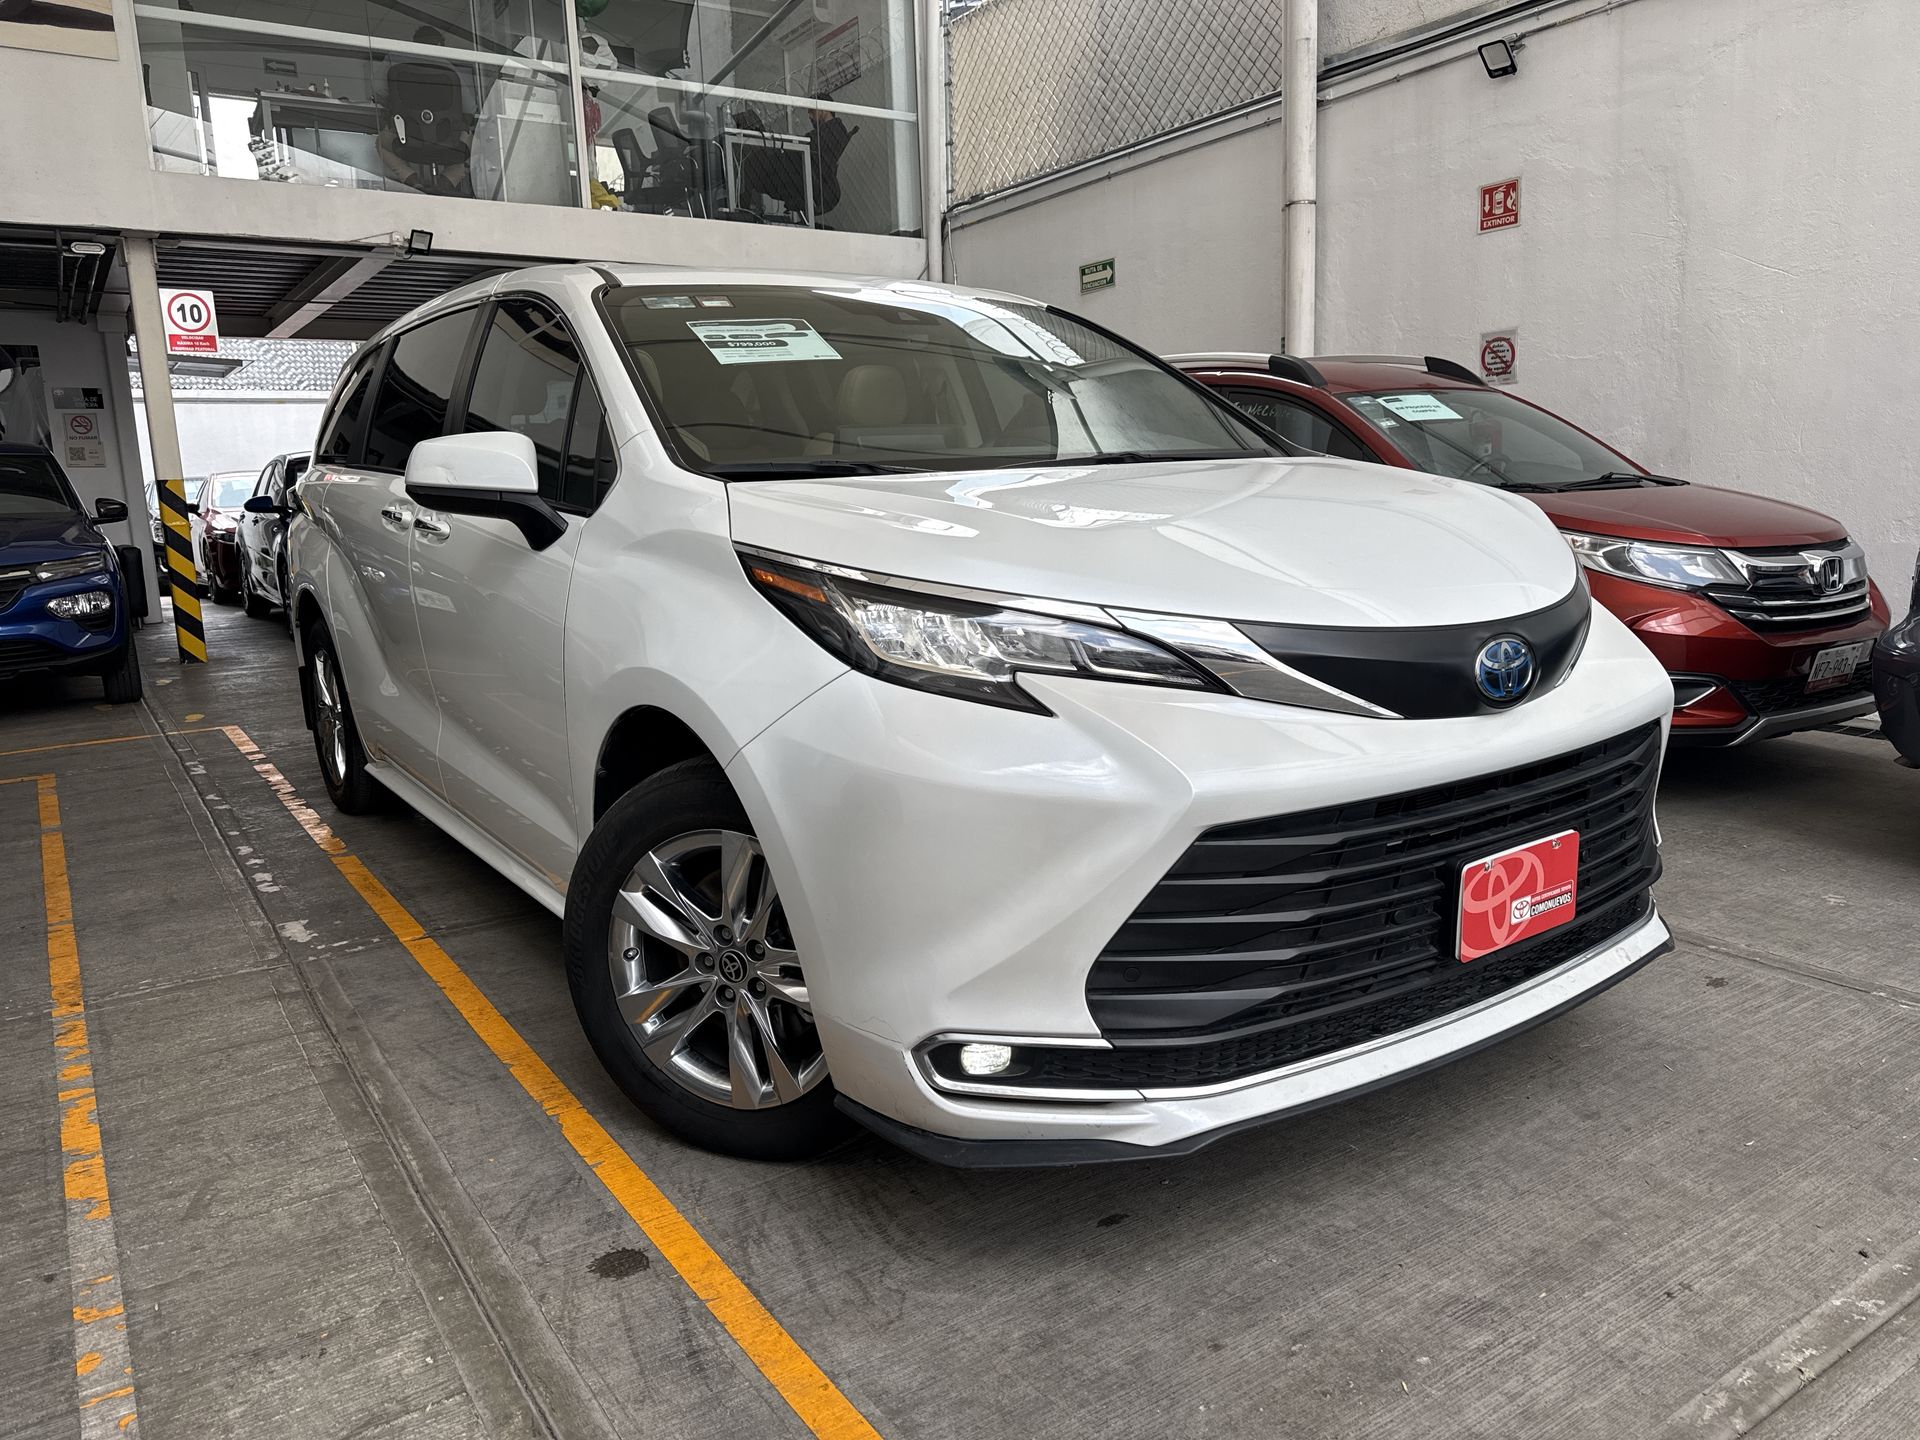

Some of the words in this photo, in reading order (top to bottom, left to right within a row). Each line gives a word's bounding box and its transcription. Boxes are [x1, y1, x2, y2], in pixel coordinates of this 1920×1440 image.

[1483, 215, 1515, 228] EXTINTOR
[1097, 264, 1103, 272] DE
[176, 303, 203, 323] 10
[1531, 893, 1571, 915] COMONUEVOS
